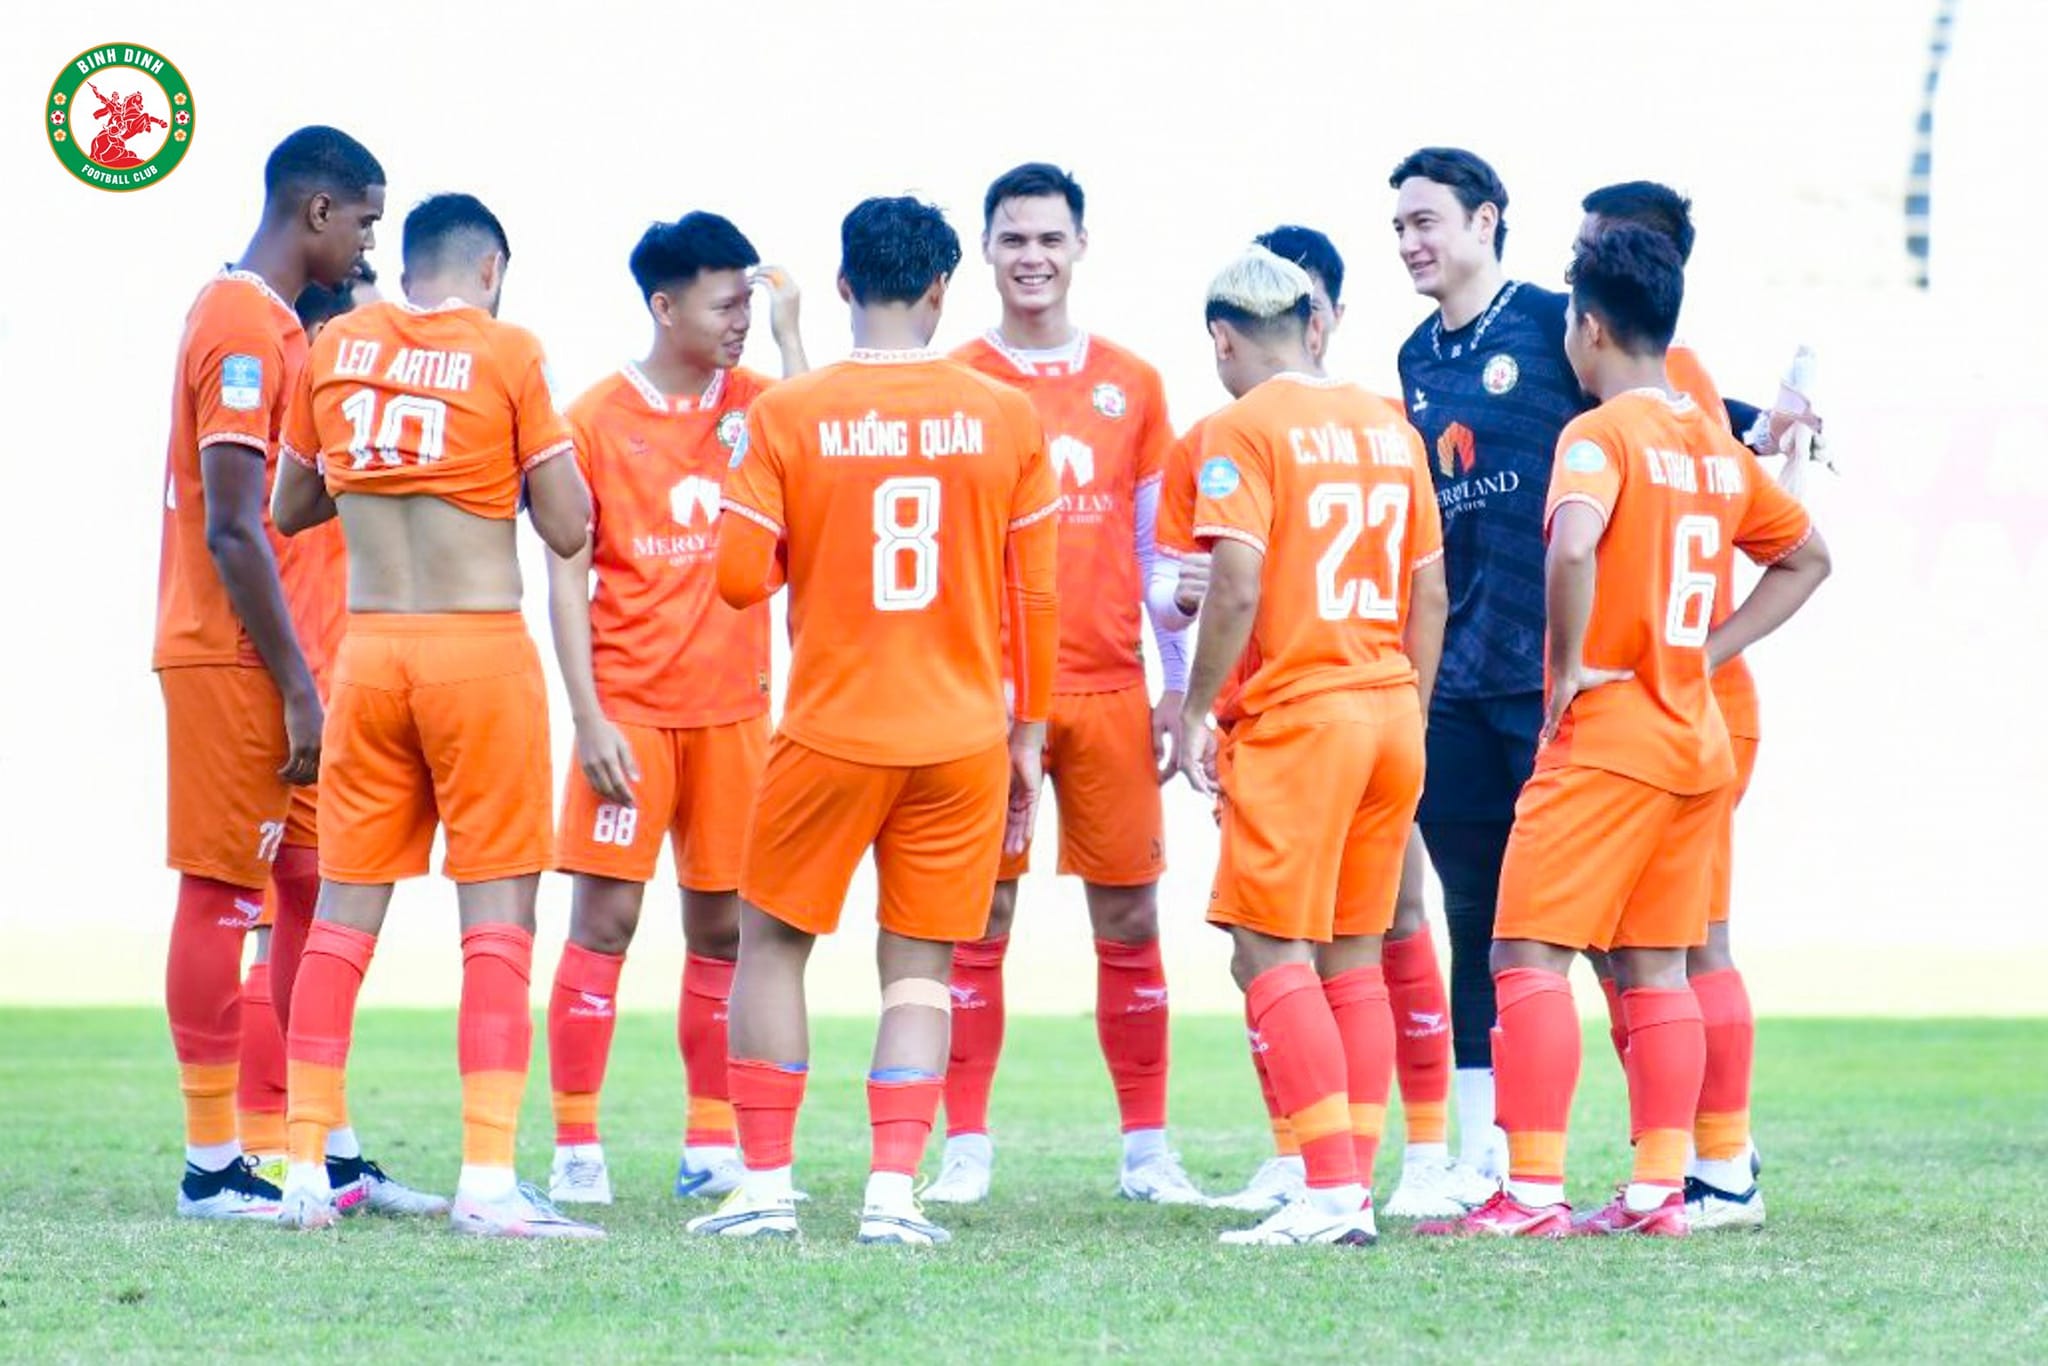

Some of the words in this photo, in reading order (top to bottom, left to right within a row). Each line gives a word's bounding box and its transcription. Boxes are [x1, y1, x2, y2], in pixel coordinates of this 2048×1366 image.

[333, 337, 381, 376] LEO
[388, 349, 473, 392] ARTUR
[341, 388, 446, 470] 10
[920, 410, 983, 459] QUÂN
[872, 475, 941, 612] 8
[1308, 482, 1411, 621] 23
[1665, 514, 1720, 648] 6
[592, 803, 637, 847] 88
